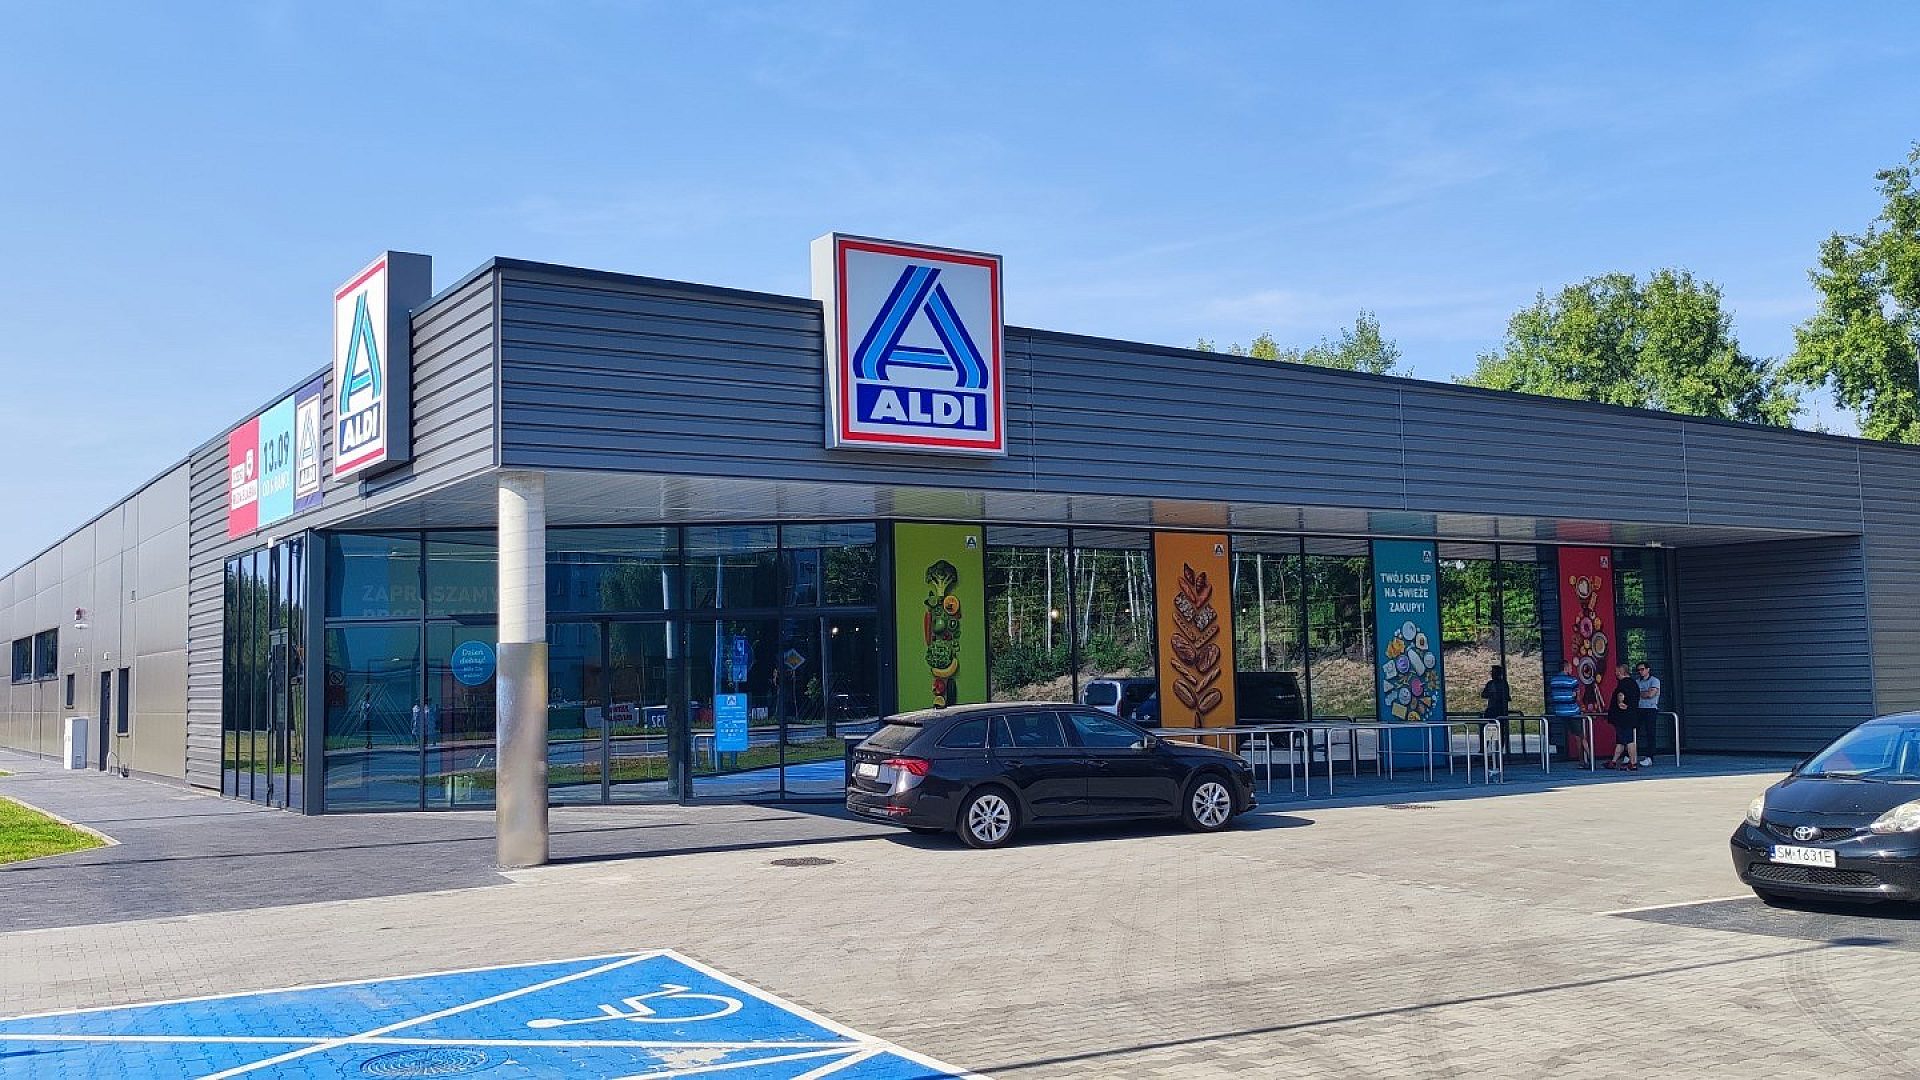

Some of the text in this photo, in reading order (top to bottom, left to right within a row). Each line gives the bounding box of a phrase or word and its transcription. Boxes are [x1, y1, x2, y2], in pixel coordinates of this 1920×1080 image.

[870, 388, 977, 428] ALDI
[342, 406, 379, 452] ALDI
[263, 430, 290, 475] 13.09
[1380, 571, 1432, 584] TWÓJ SKLEP
[1384, 585, 1429, 598] NA ŚWIEŻE
[1389, 602, 1425, 613] ZAKUPY!
[1776, 846, 1833, 863] SM 1631E
